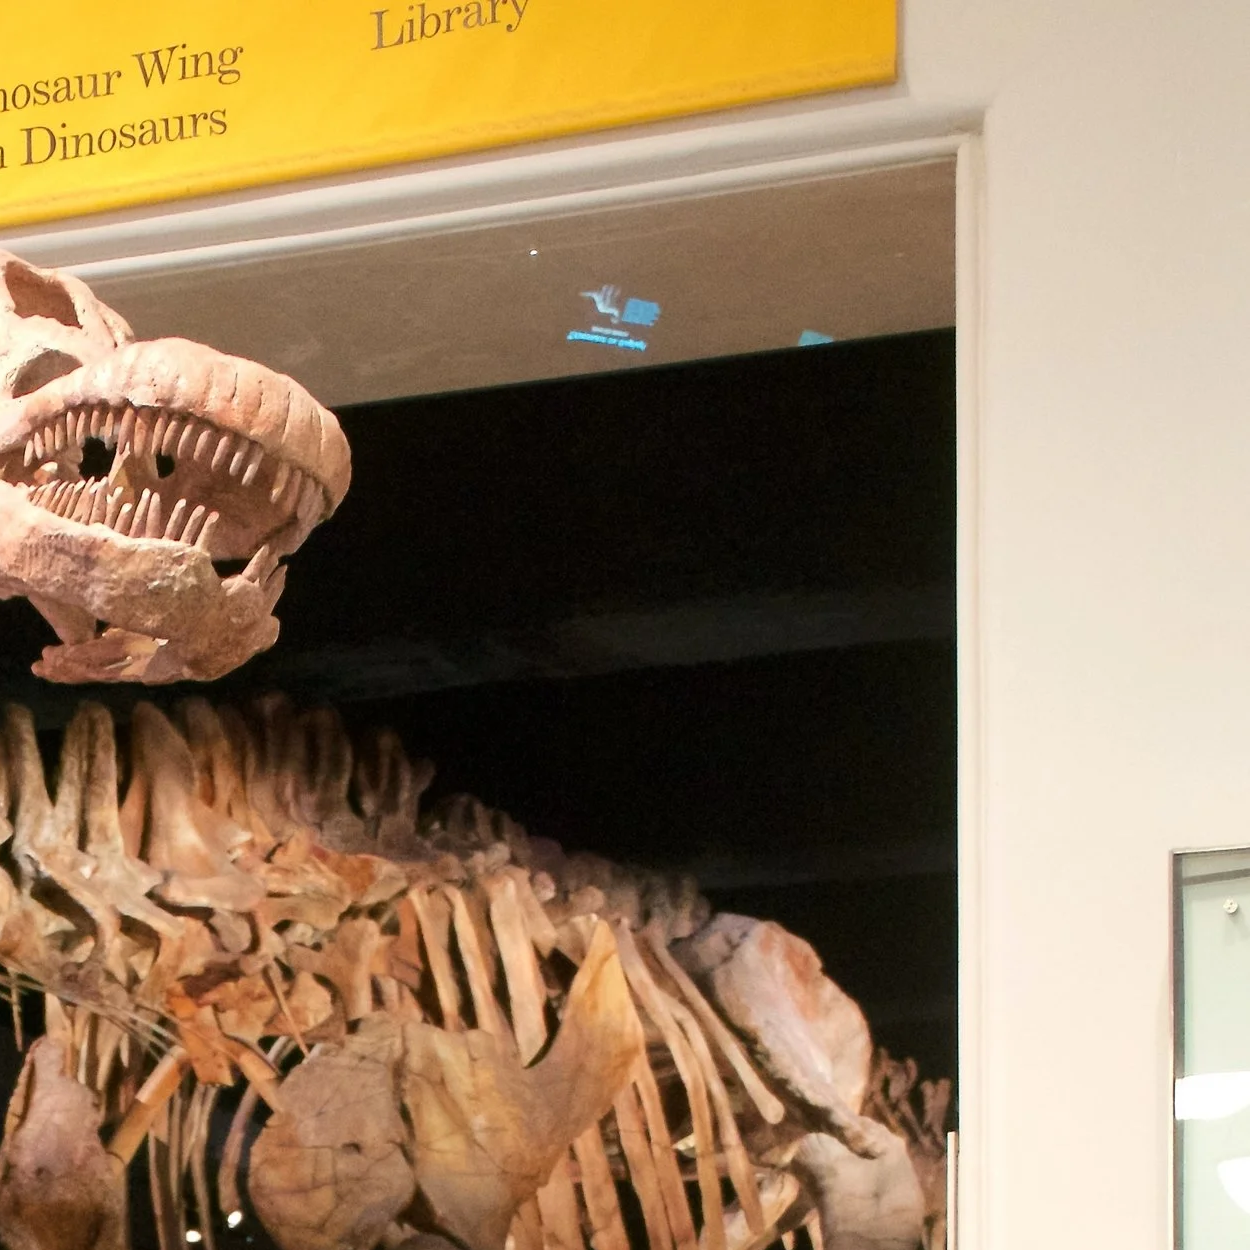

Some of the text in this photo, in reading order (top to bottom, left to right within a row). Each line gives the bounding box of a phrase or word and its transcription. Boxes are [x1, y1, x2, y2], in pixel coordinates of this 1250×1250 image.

[370, 0, 528, 50] Library
[132, 44, 243, 88] Wing
[20, 109, 227, 166] Dinosaurs
